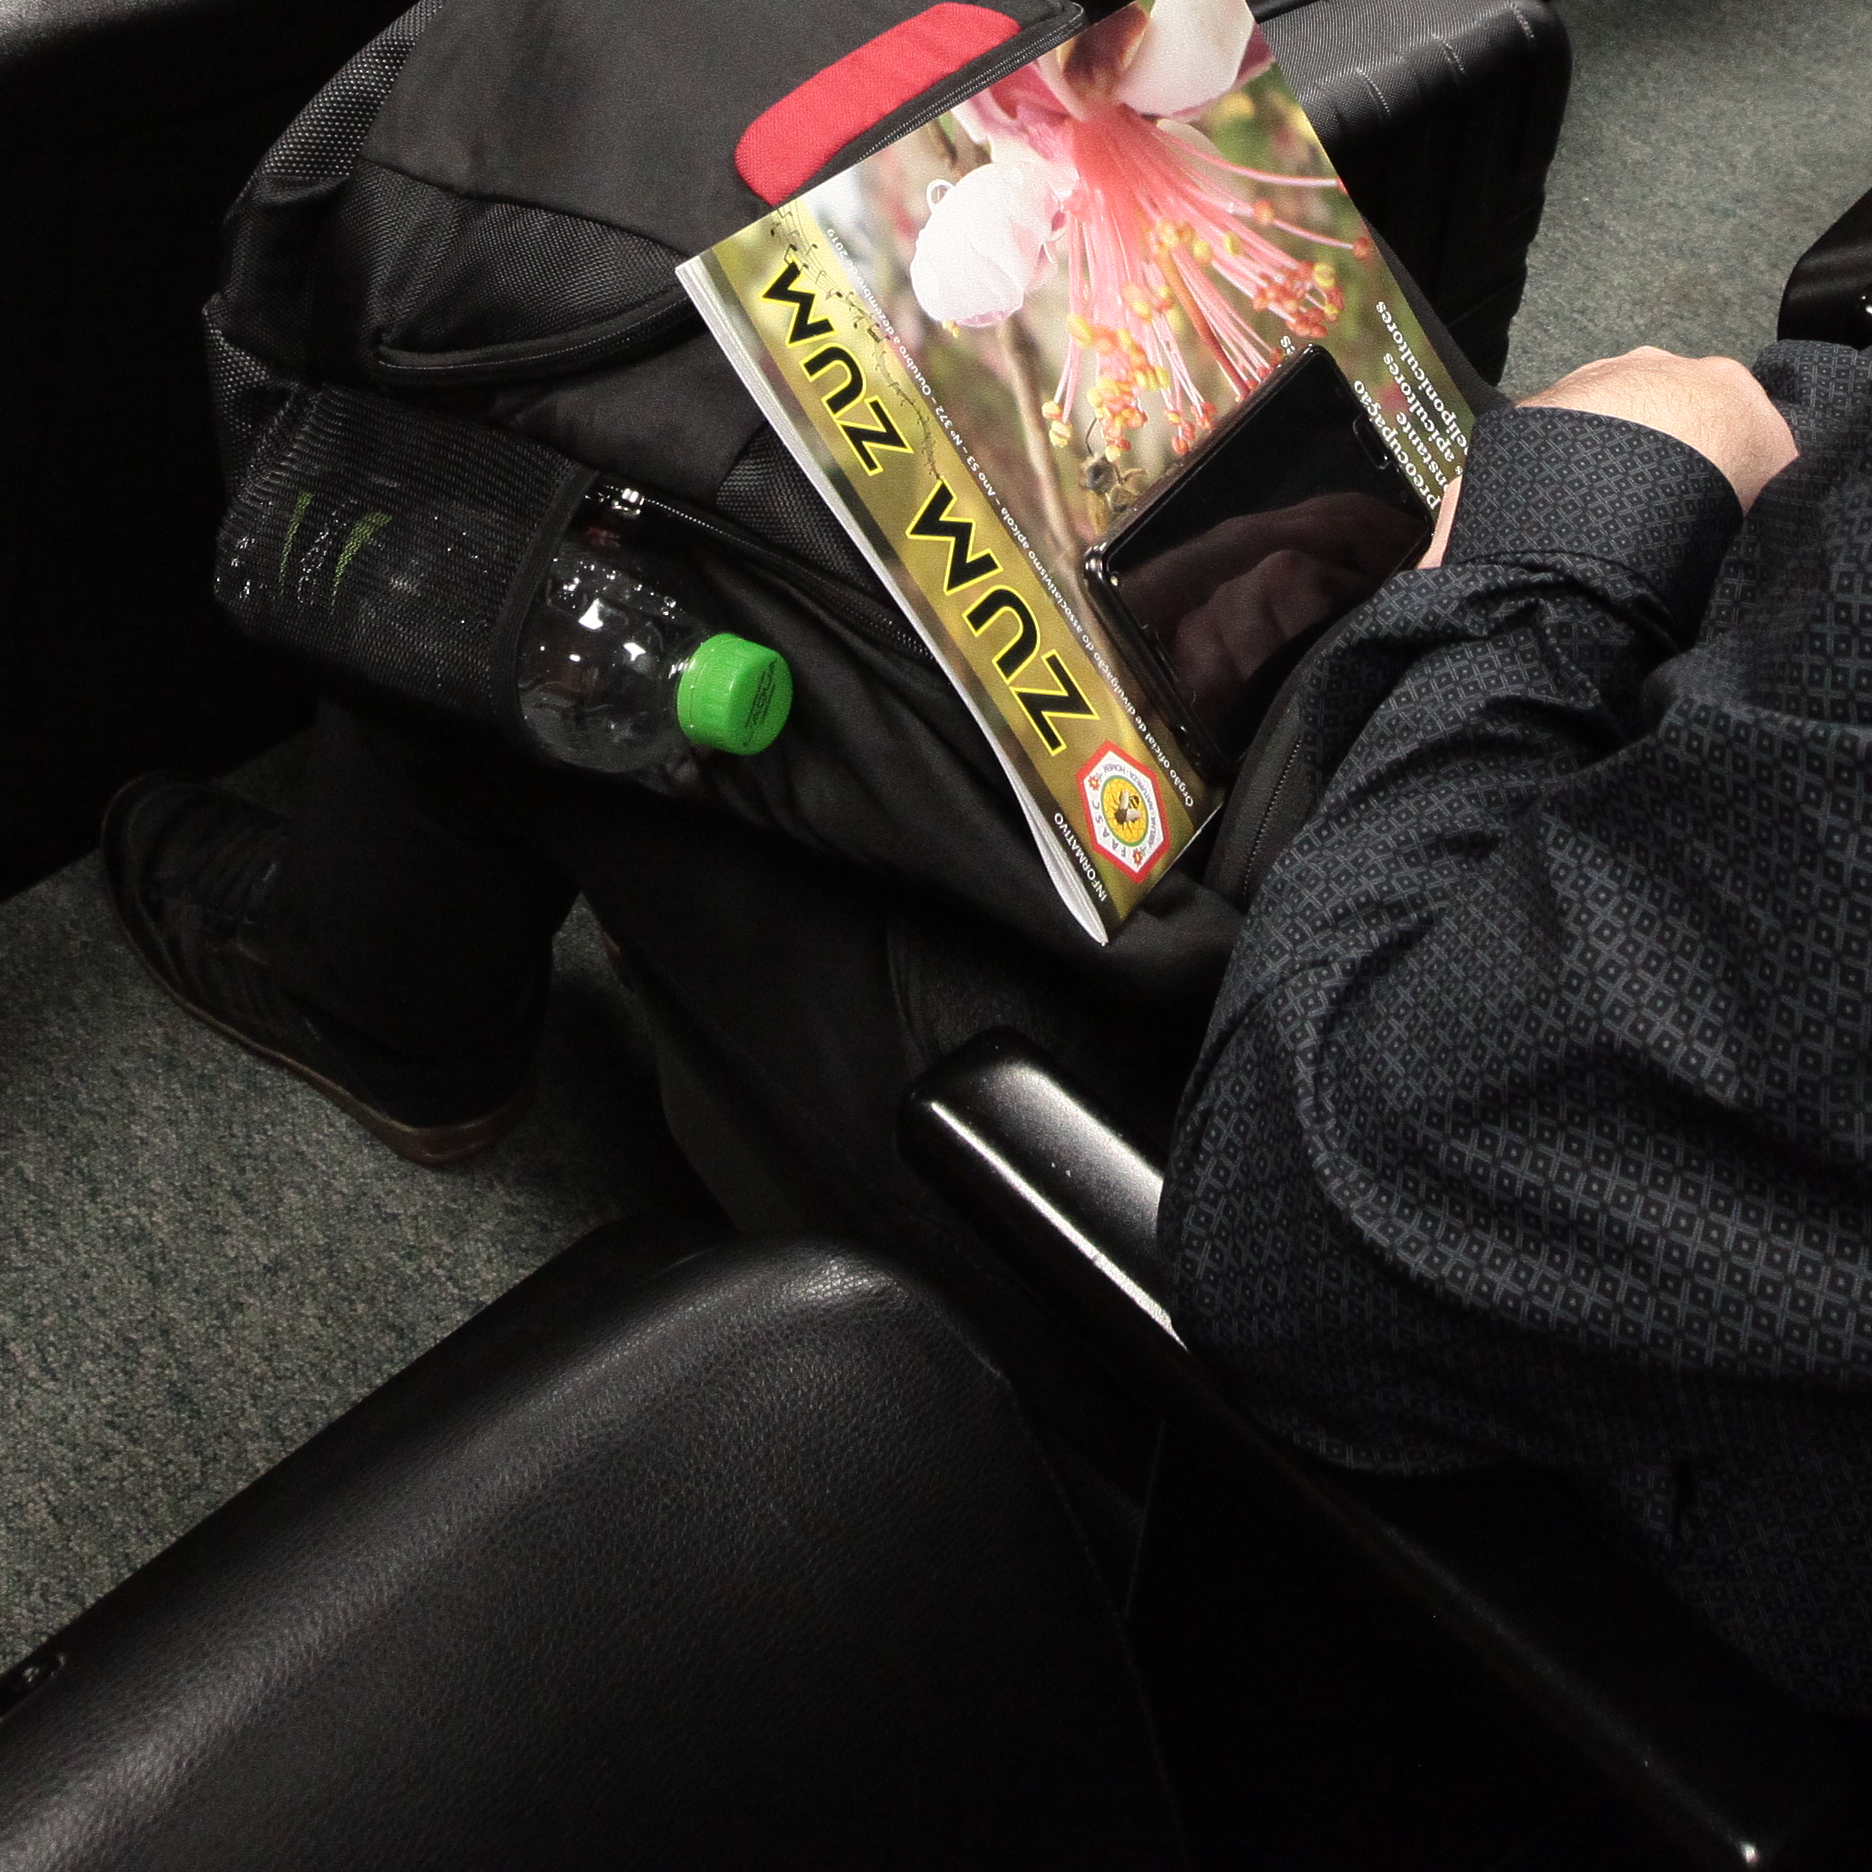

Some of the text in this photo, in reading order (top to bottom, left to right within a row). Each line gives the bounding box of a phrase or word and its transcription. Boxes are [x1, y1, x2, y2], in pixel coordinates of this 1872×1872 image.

[827, 228, 849, 257] 2019
[857, 276, 895, 336] dezembro
[899, 346, 932, 397] Outubro
[1376, 301, 1468, 456] eliponicultores
[935, 405, 954, 429] 372
[1383, 352, 1455, 462] apicultores
[966, 455, 981, 473] 53
[1353, 380, 1442, 510] preocupação
[762, 256, 1100, 757] ZUM ZUM
[978, 472, 996, 498] Ano
[1028, 549, 1084, 634] associativismo
[1081, 634, 1095, 651] do
[1092, 652, 1136, 718] divulgação
[1134, 715, 1147, 732] de
[1145, 731, 1171, 770] oficial
[1169, 769, 1194, 808] Órgão
[1091, 799, 1127, 858] FAASC
[1054, 812, 1108, 902] INFORMATIVO
